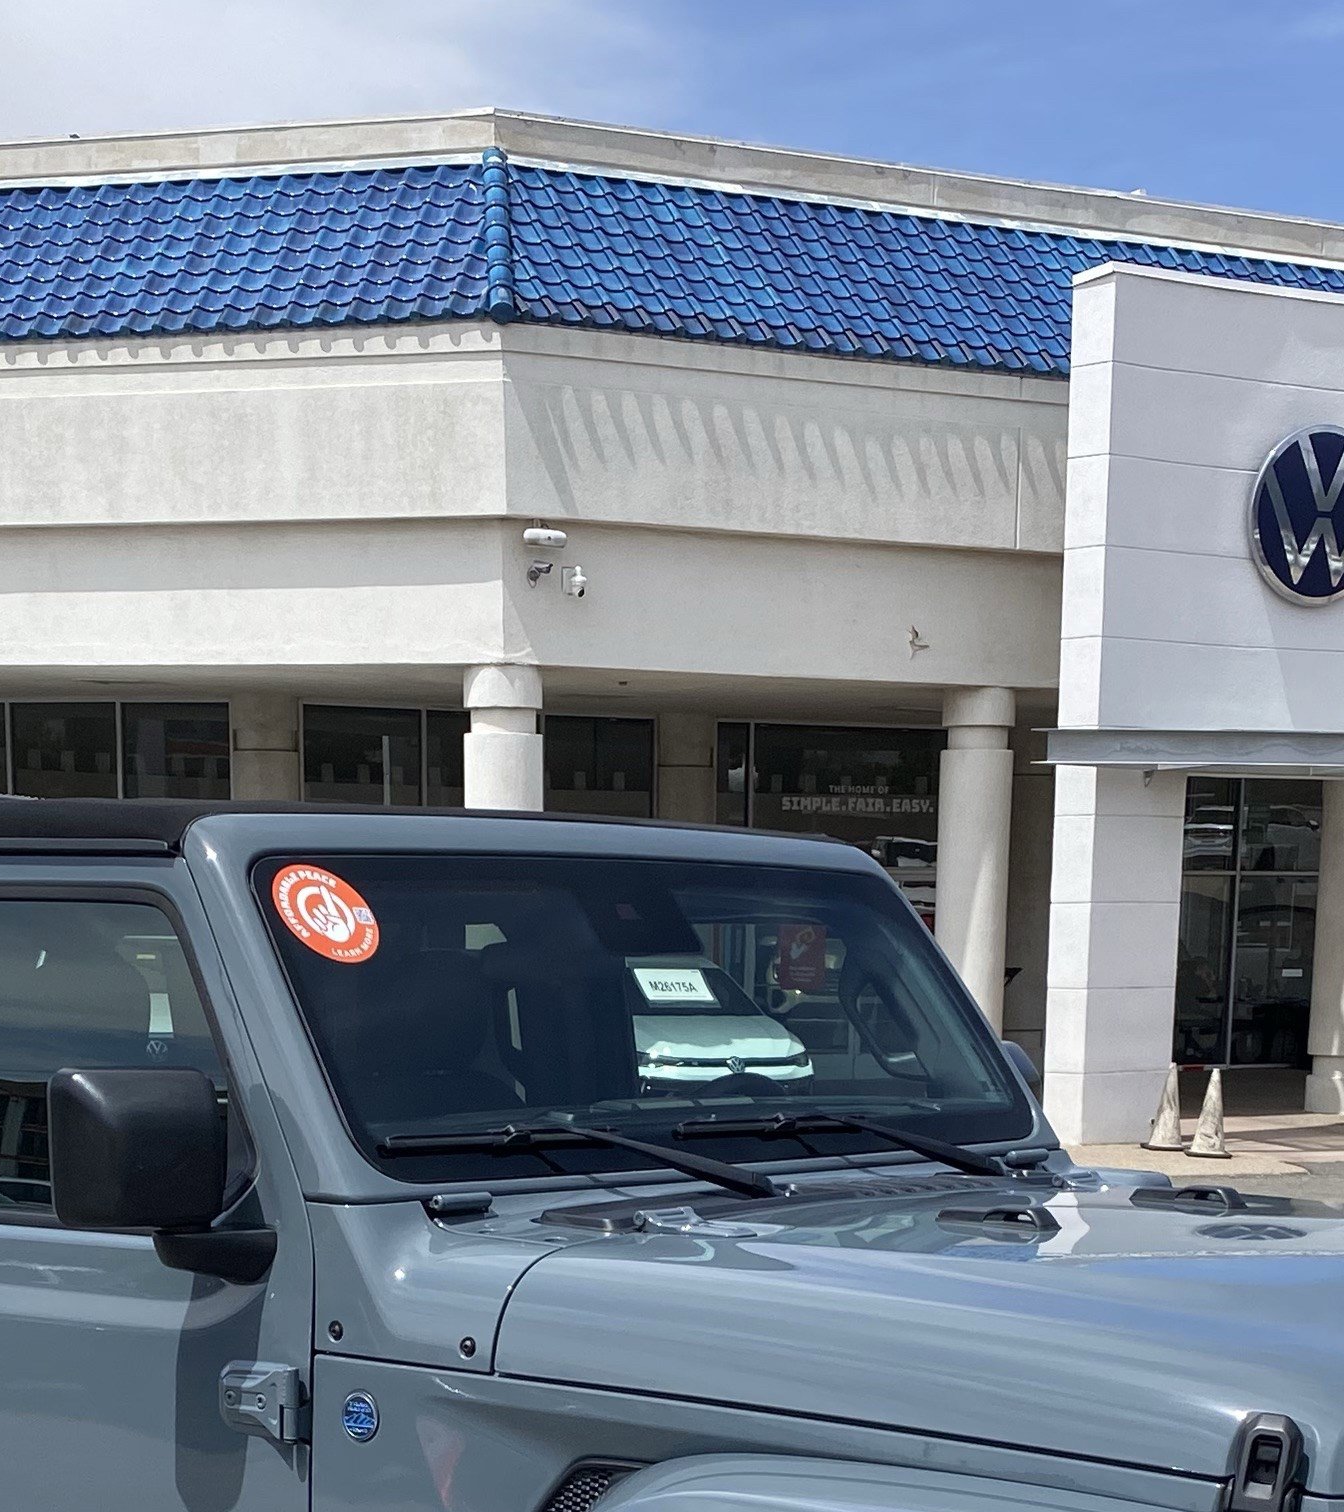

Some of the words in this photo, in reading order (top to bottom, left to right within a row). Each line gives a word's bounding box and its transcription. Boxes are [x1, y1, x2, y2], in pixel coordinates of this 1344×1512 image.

[829, 784, 846, 794] THE
[847, 785, 874, 795] HOME
[877, 785, 890, 795] OF
[297, 869, 337, 888] PEACE
[331, 947, 363, 957] LEARN
[360, 927, 374, 952] MORE
[648, 981, 699, 993] M26175A
